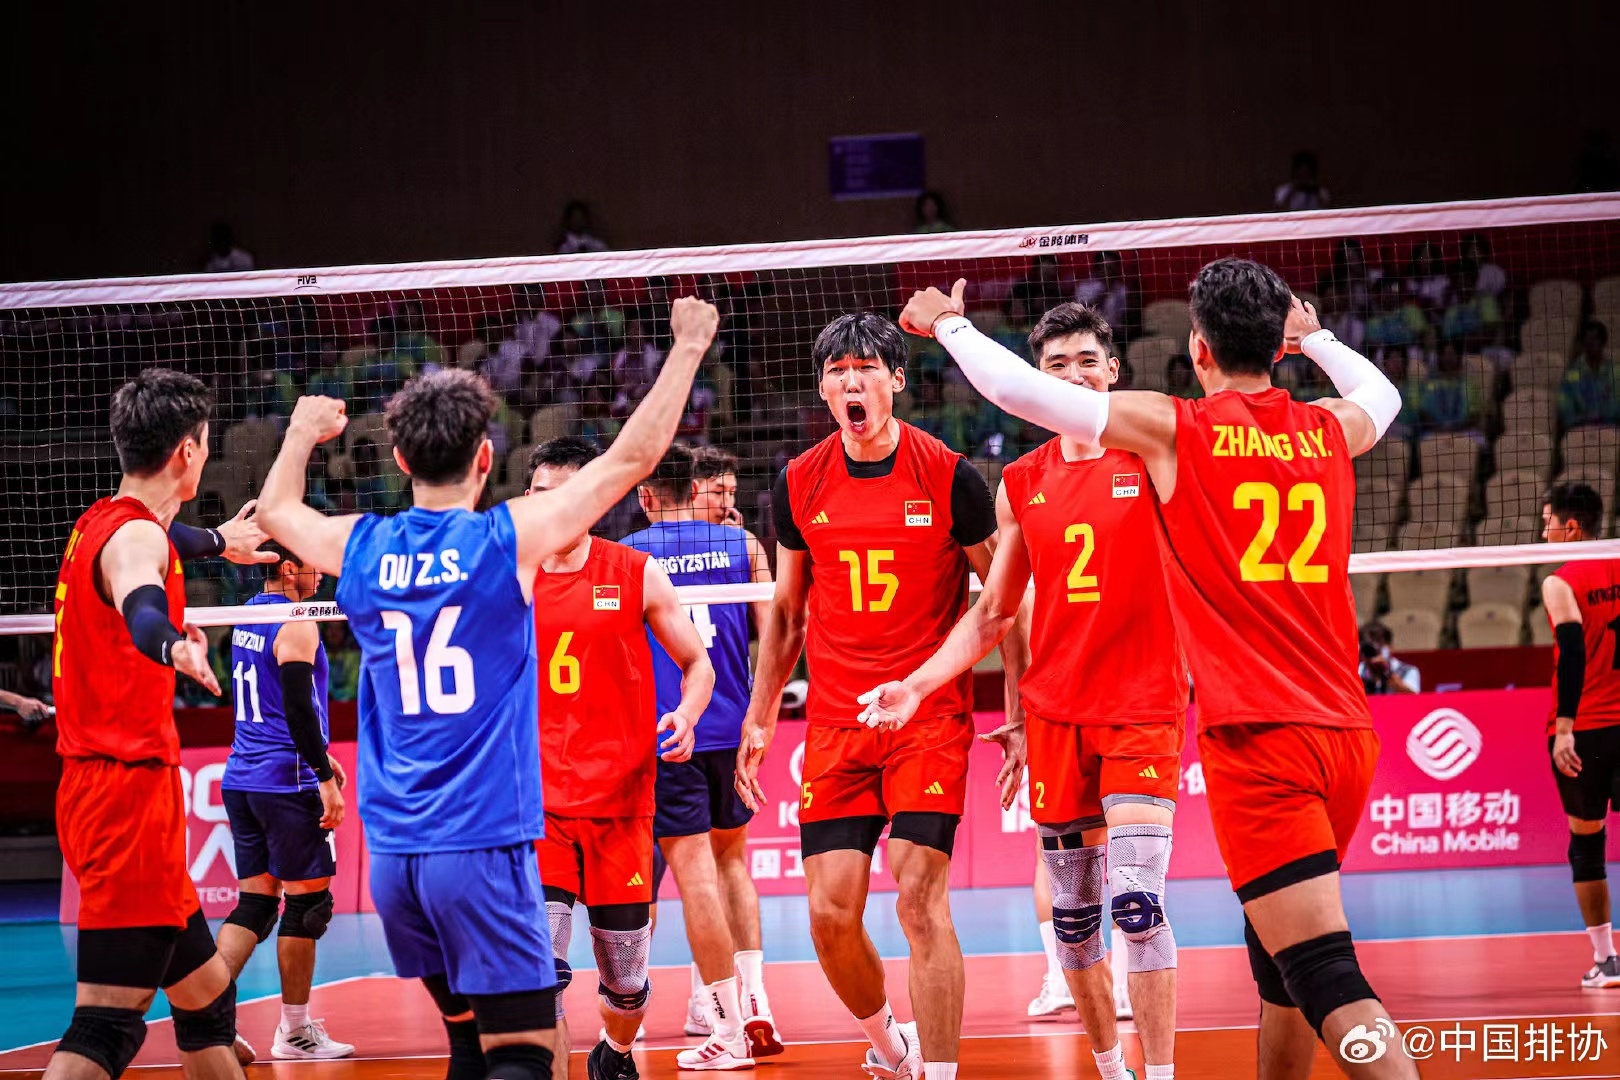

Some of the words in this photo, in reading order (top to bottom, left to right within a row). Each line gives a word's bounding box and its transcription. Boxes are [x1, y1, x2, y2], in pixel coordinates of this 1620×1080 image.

[1212, 424, 1295, 462] ZHANG
[1296, 427, 1333, 459] J.Y.
[1115, 488, 1137, 496] CHN
[1064, 522, 1099, 589] 2
[1233, 481, 1329, 583] 22
[378, 553, 414, 591] QU
[415, 548, 469, 587] Z.S.
[838, 549, 900, 612] 15
[380, 605, 476, 716] 16
[549, 631, 581, 695] 6
[232, 660, 265, 723] 11
[1035, 781, 1045, 809] 2
[1370, 789, 1521, 831] 中国移动
[1371, 831, 1440, 856] China
[1443, 827, 1520, 853] Mobile
